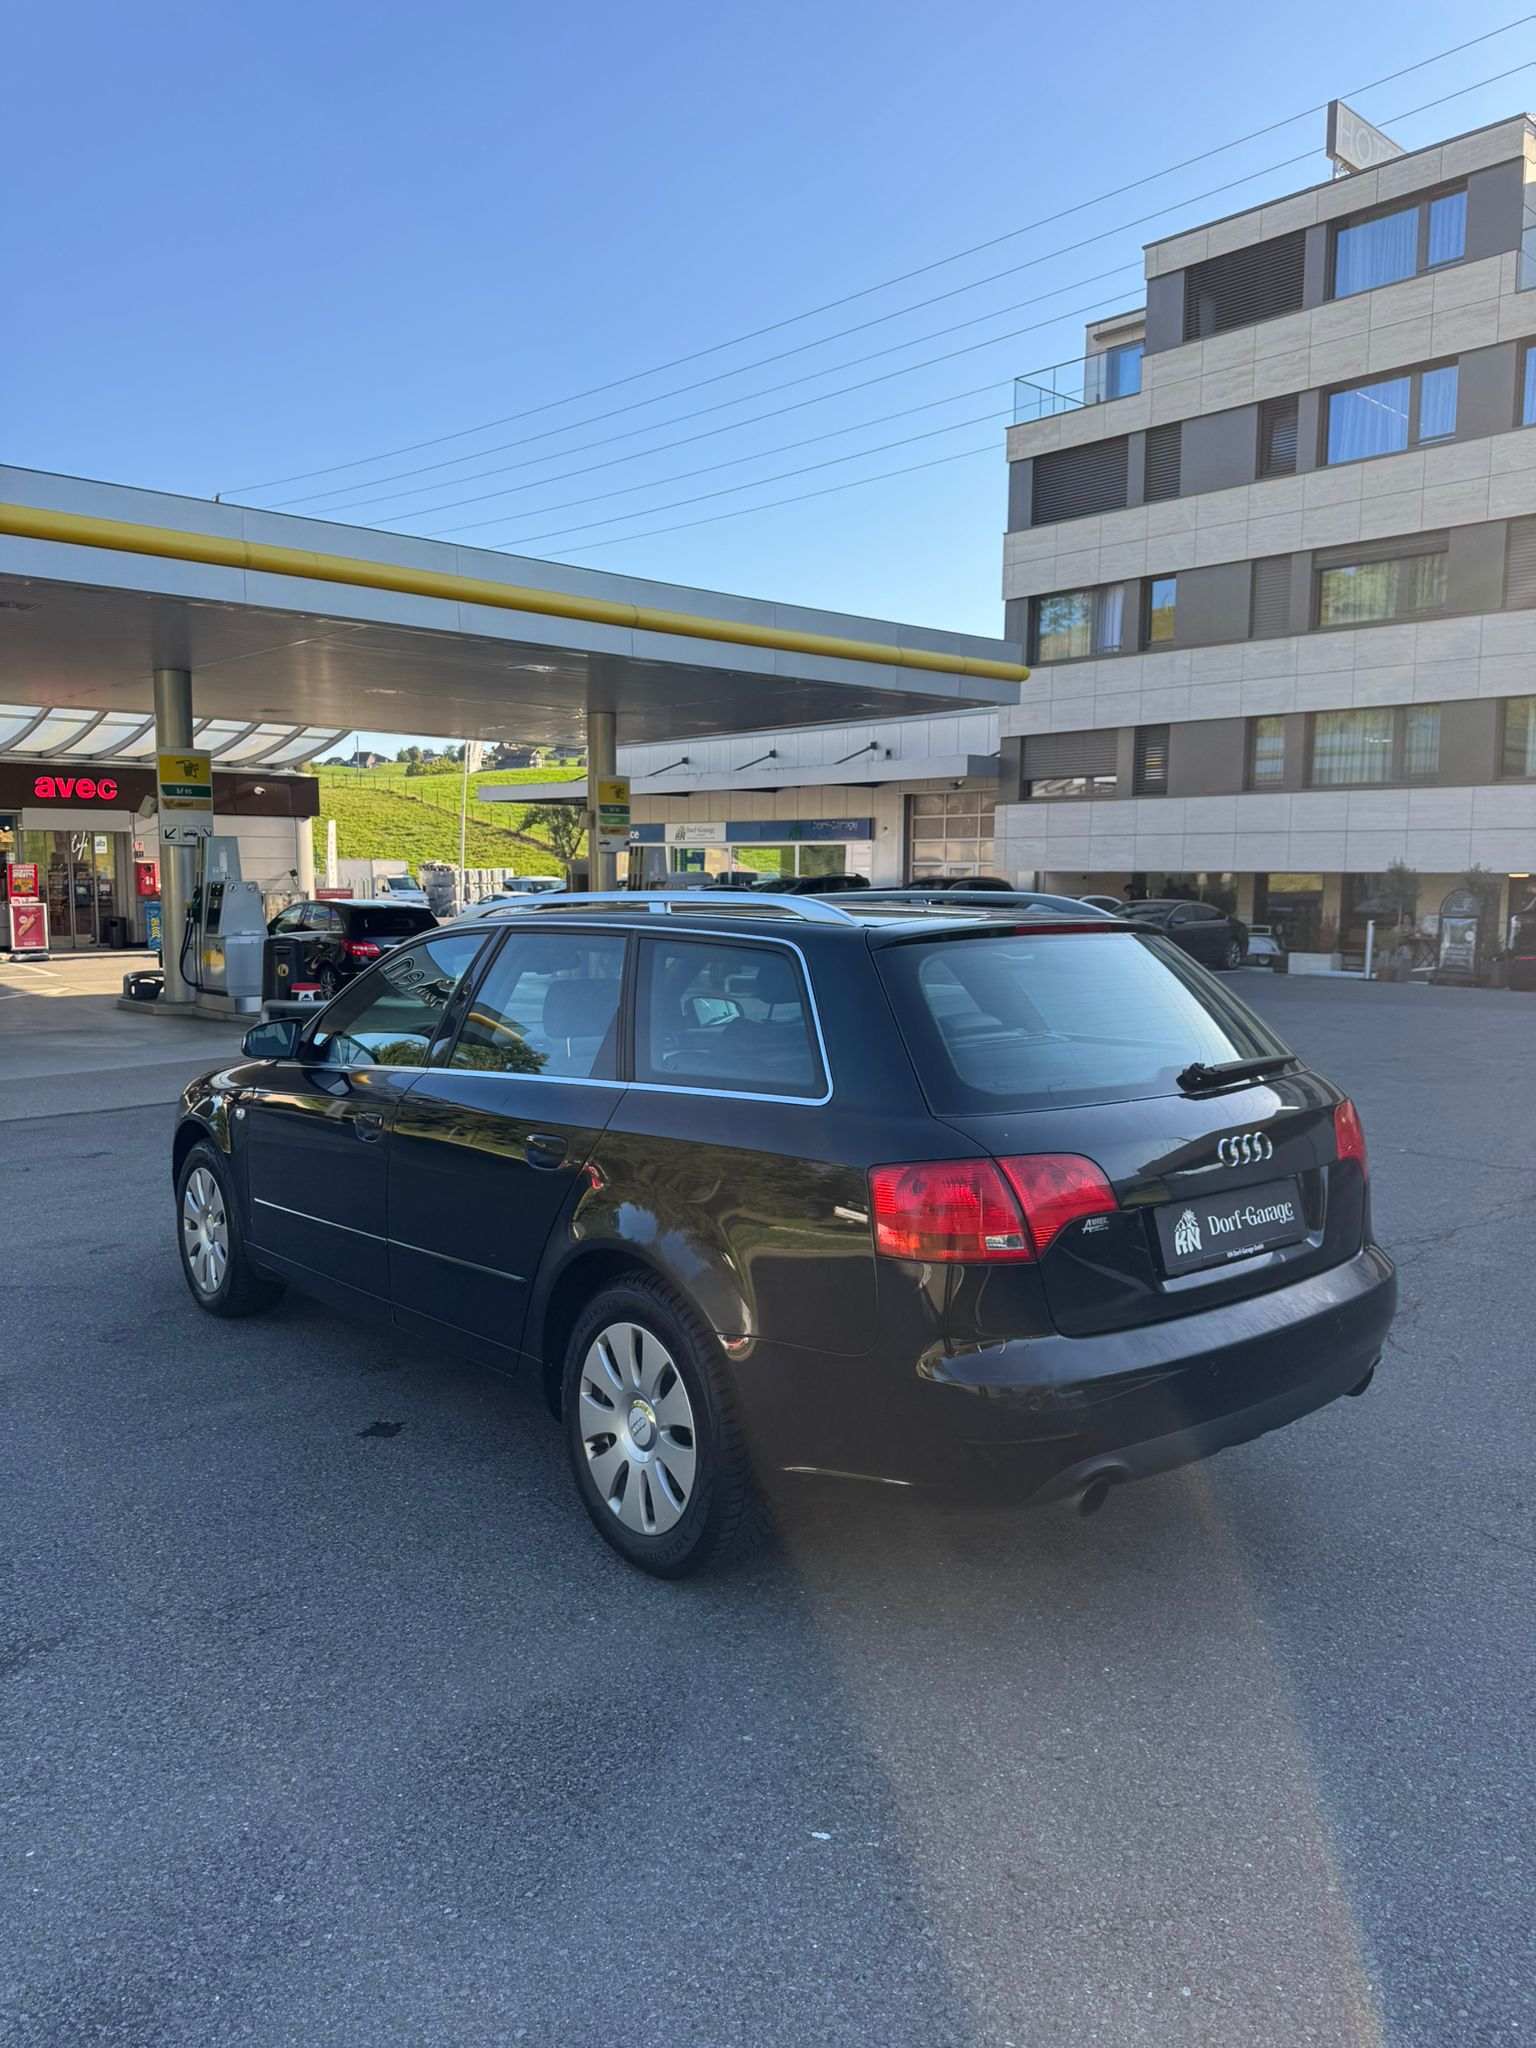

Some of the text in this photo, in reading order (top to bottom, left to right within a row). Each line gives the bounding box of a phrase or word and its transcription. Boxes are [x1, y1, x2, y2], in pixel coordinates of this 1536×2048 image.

[34, 776, 118, 800] avec
[1174, 1202, 1294, 1256] KN Dorf-Garage
